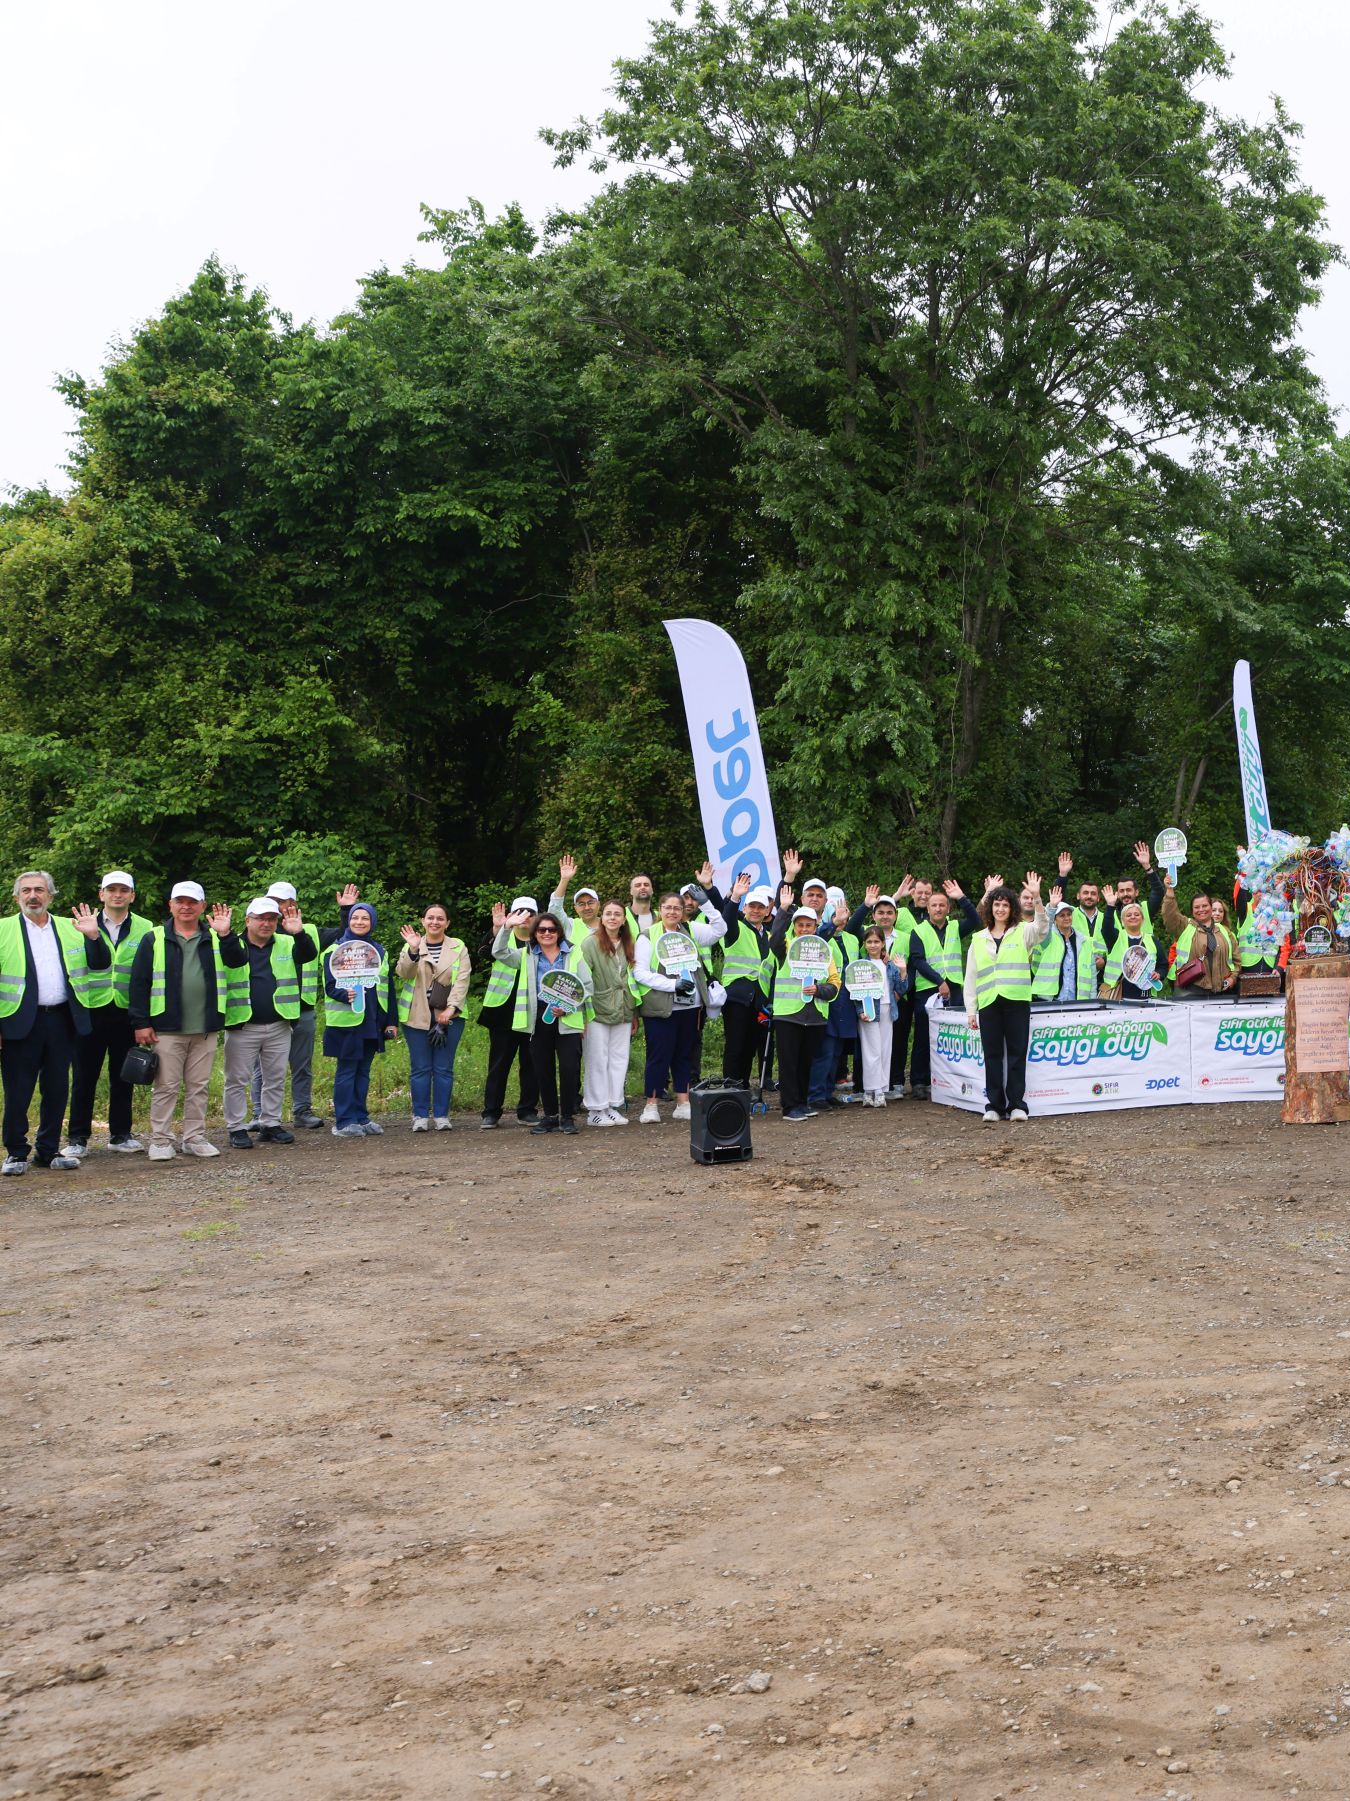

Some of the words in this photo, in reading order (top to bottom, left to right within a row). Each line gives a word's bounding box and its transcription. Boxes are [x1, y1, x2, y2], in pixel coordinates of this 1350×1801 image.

[1106, 1020, 1153, 1038] doğaya
[1216, 1029, 1285, 1056] saygı
[937, 1034, 964, 1062] saygı
[1030, 1037, 1099, 1065] saygı
[1103, 1033, 1151, 1059] duy
[1145, 1076, 1181, 1091] opet
